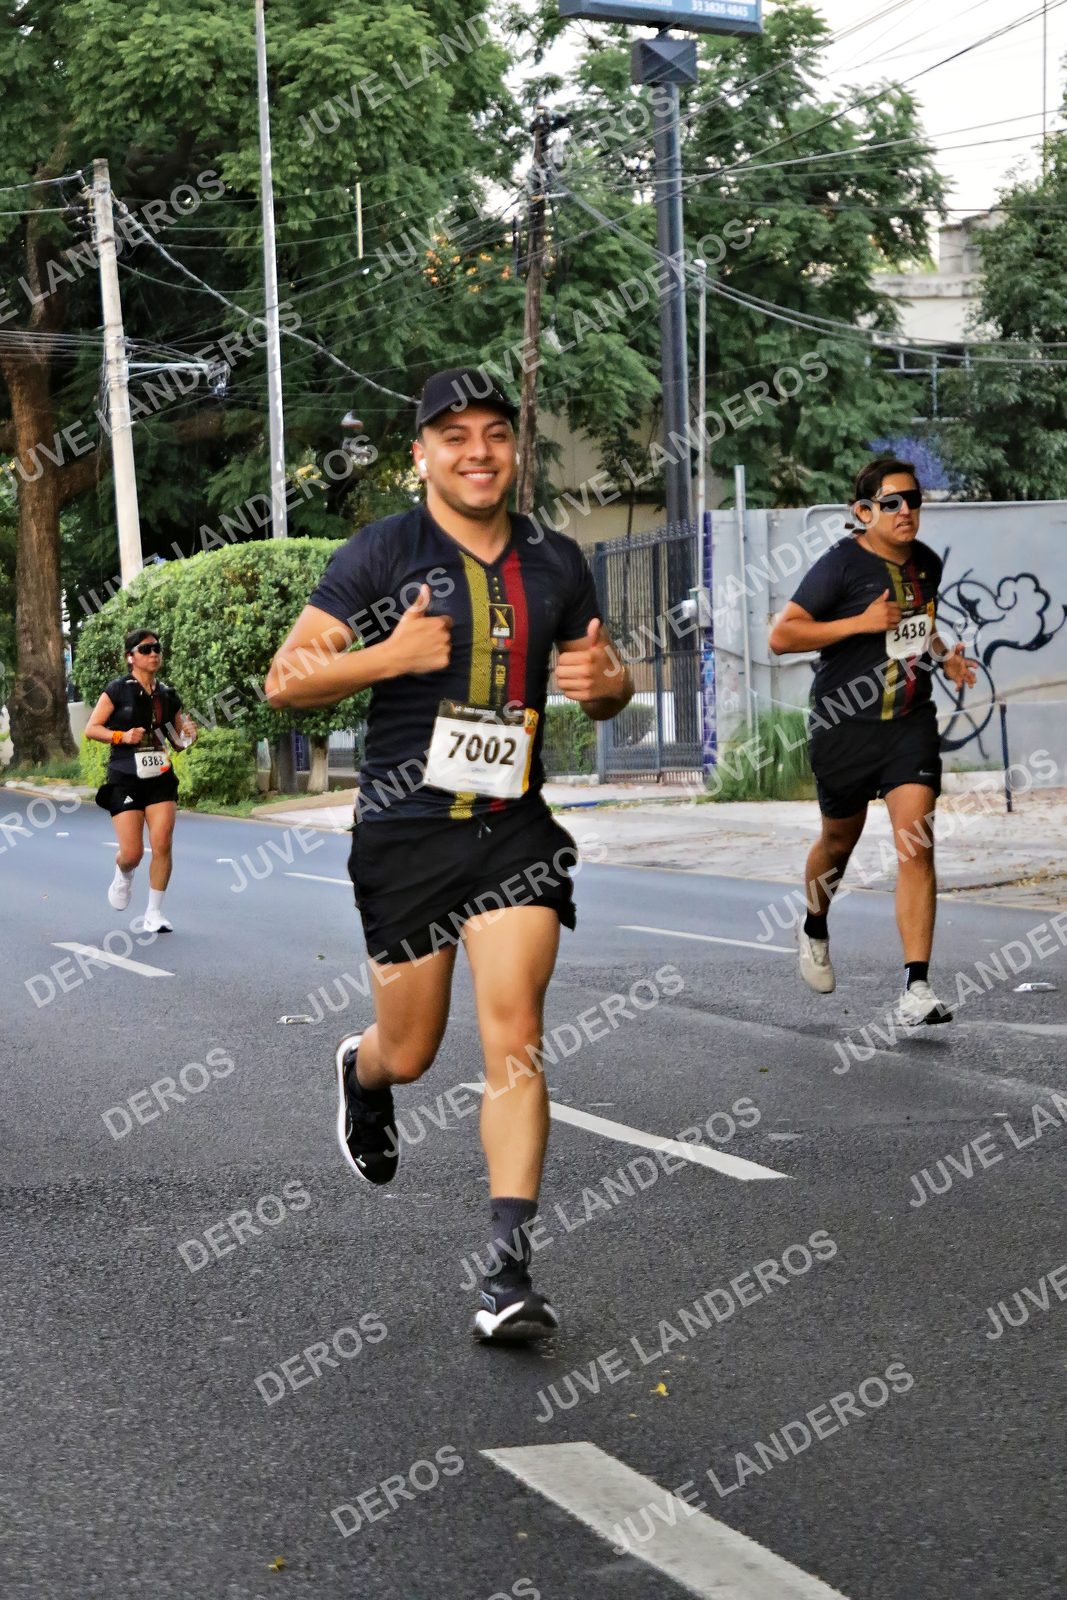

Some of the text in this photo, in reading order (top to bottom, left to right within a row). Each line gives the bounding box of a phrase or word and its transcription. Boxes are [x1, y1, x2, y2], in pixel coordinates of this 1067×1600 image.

[893, 621, 926, 642] 3438
[447, 730, 517, 766] 7002
[141, 755, 164, 767] 6383
